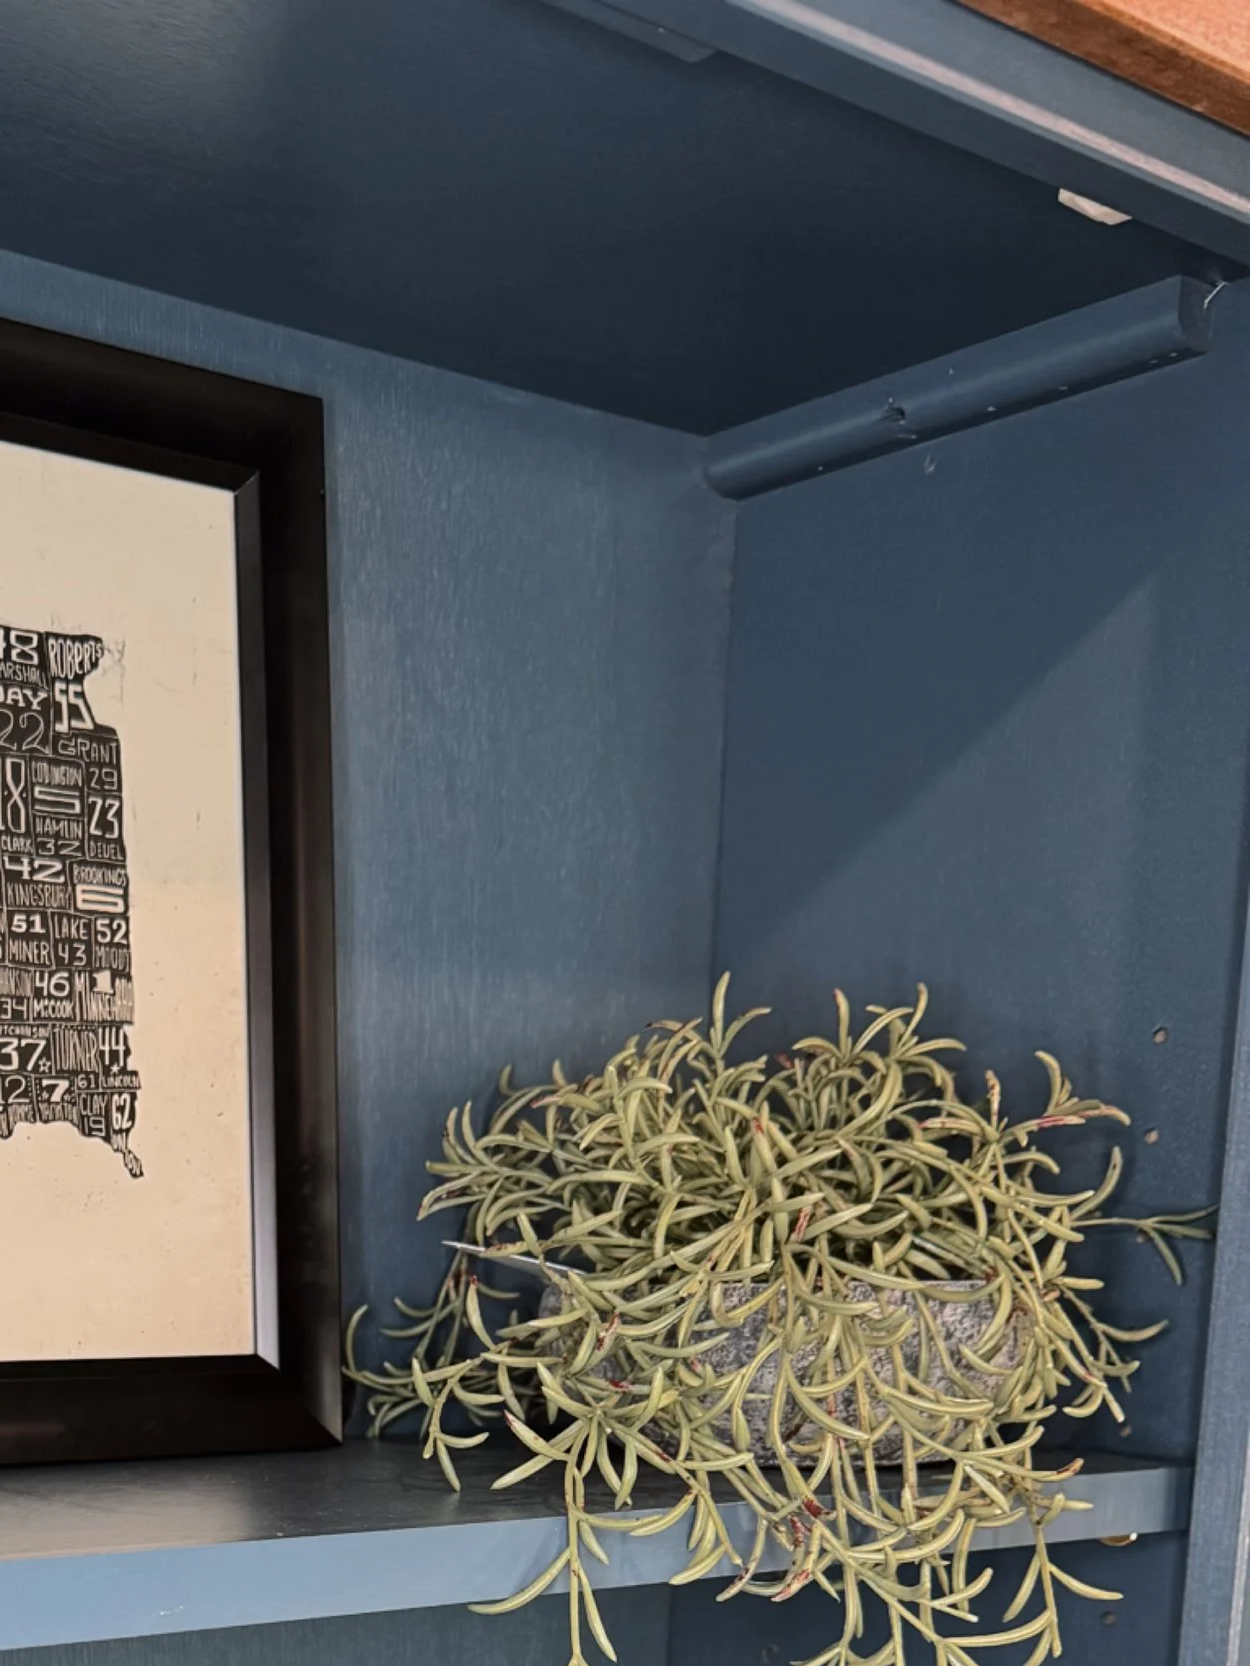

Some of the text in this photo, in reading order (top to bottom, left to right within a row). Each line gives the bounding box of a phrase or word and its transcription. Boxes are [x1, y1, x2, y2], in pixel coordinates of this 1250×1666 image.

[58, 738, 117, 764] GRANT
[88, 768, 117, 790] 29
[36, 817, 83, 839] HAMLIN
[87, 797, 120, 839] 23
[1, 836, 34, 854] CLARK
[37, 838, 83, 856] 32
[3, 855, 65, 883] 42
[76, 885, 125, 914] 6
[11, 914, 46, 933] 51
[54, 915, 89, 940] LAKE
[95, 918, 128, 945] 52
[8, 939, 50, 965] MINER
[58, 944, 86, 966] 43
[35, 971, 71, 998] 46
[0, 997, 28, 1020] 34
[100, 1026, 126, 1066] 44
[42, 1078, 69, 1102] 7
[78, 1075, 96, 1089] 61
[80, 1094, 108, 1116] CLAY
[112, 1093, 132, 1130] 62
[83, 1116, 106, 1137] 19
